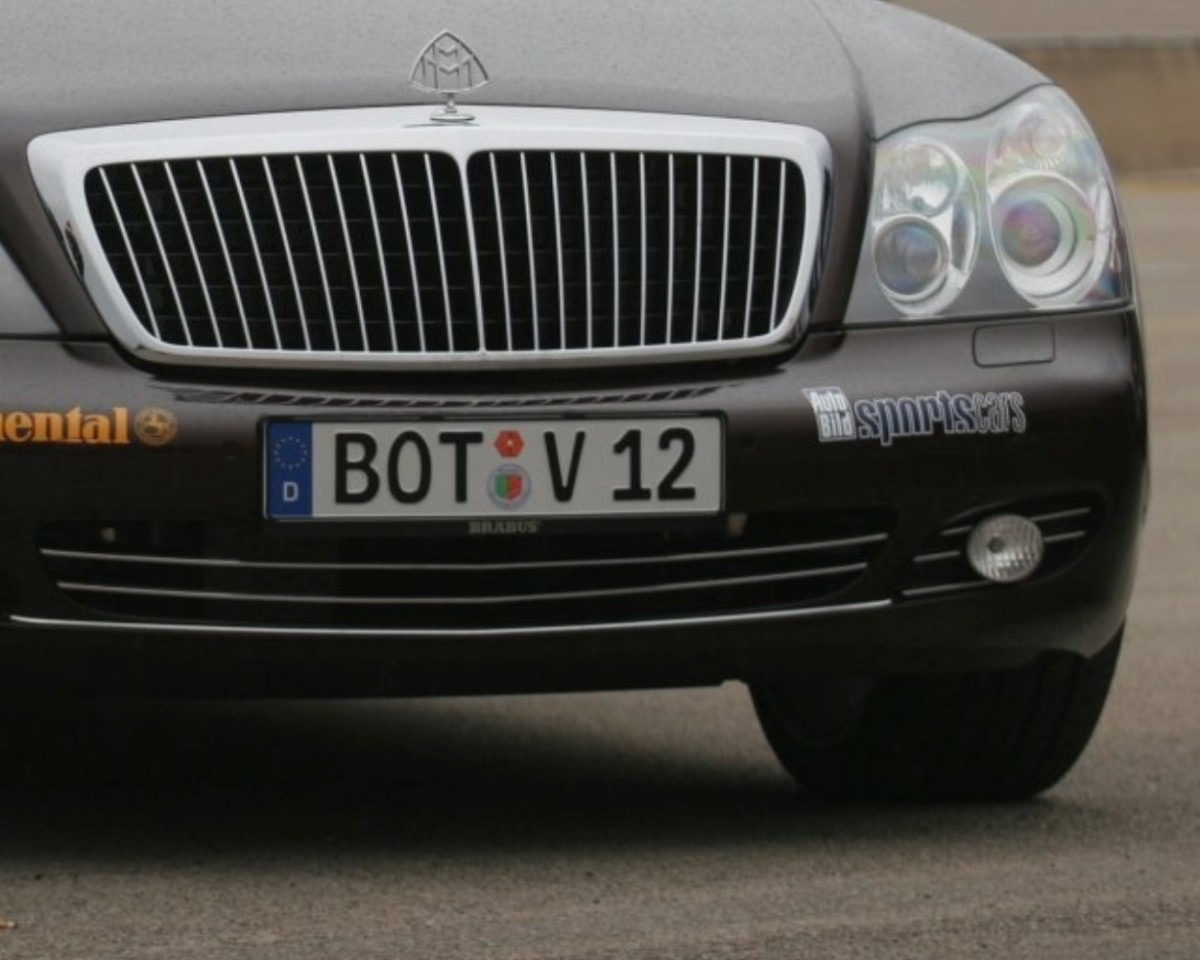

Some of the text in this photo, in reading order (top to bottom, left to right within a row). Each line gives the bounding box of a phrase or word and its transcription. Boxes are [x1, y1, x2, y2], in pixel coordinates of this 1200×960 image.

[855, 391, 1026, 446] sportscars
[282, 480, 300, 502] D
[335, 427, 696, 504] BOT V 12
